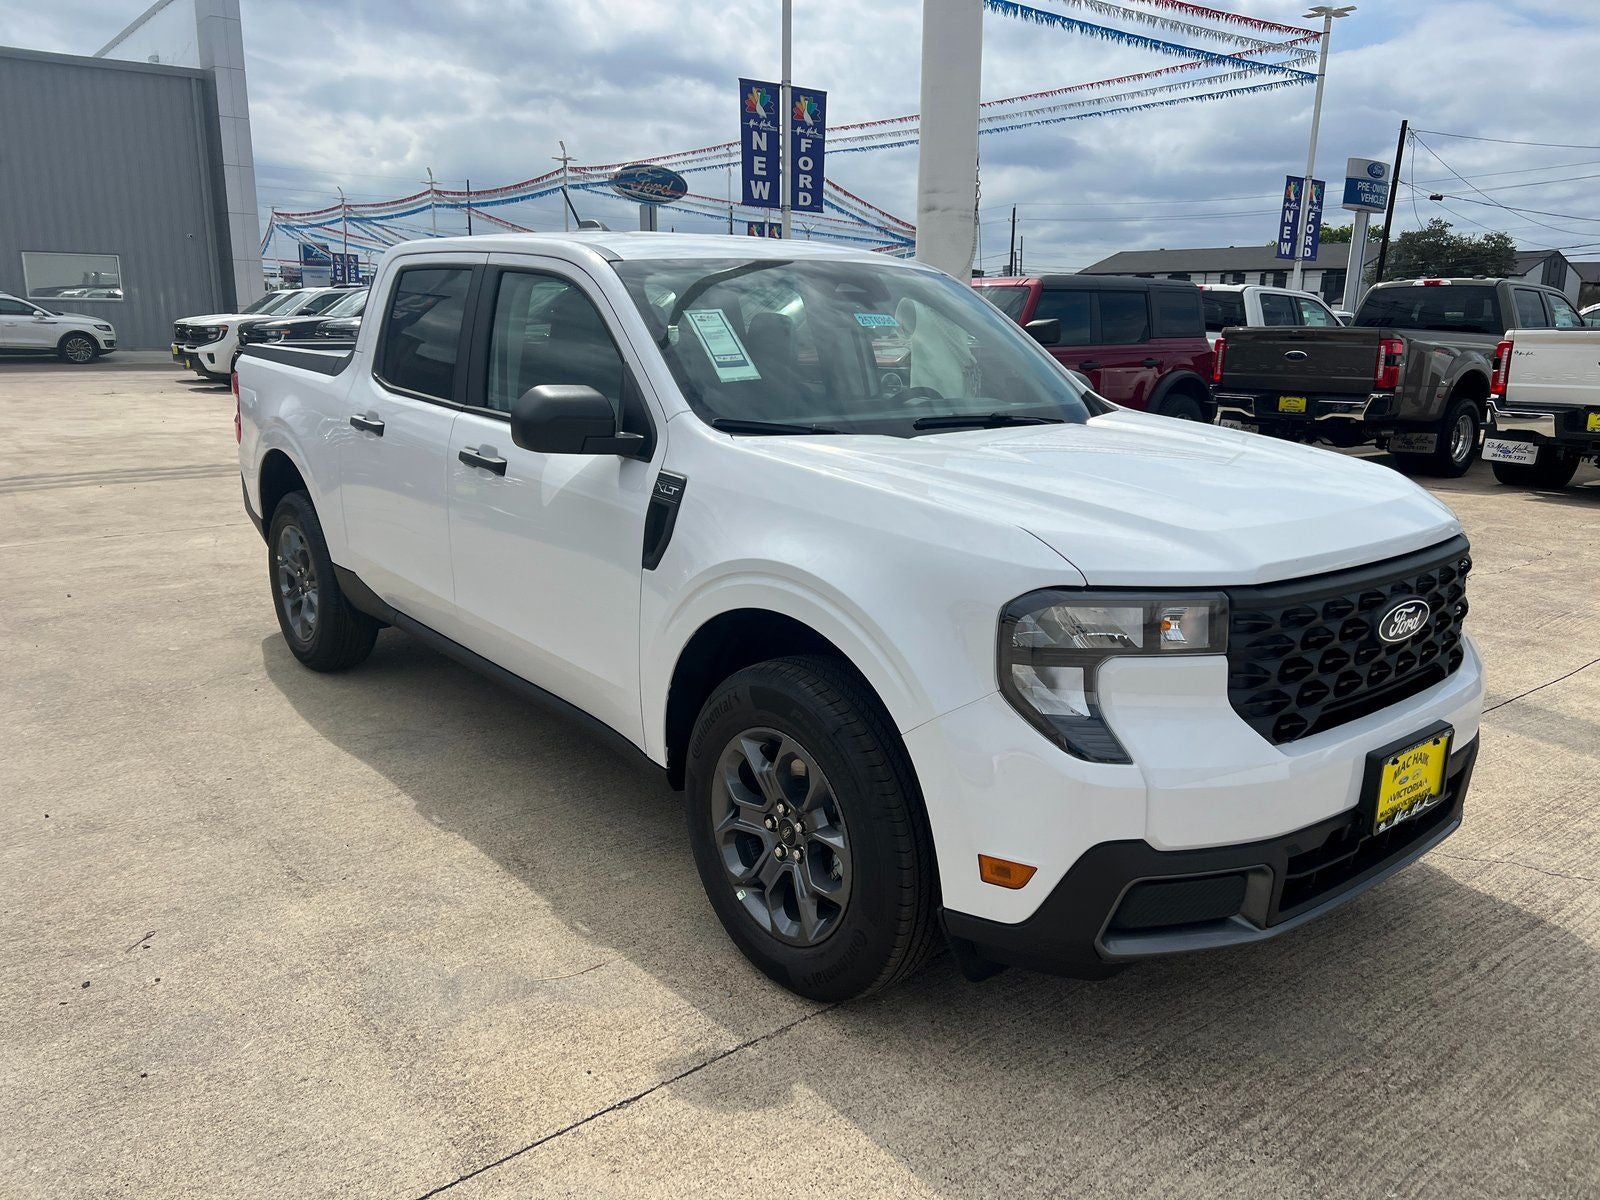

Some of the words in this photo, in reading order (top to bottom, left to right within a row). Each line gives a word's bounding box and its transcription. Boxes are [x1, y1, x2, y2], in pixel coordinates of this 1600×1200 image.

[631, 170, 675, 195] Ford
[749, 130, 771, 200] NEW
[797, 138, 814, 206] FORD
[1360, 192, 1385, 205] VEHICLES
[1280, 210, 1294, 255] NEW
[1303, 212, 1316, 257] FORD
[656, 482, 680, 496] XLT
[1388, 605, 1423, 637] Ford
[691, 694, 734, 759] Continental
[1392, 755, 1412, 783] MAC
